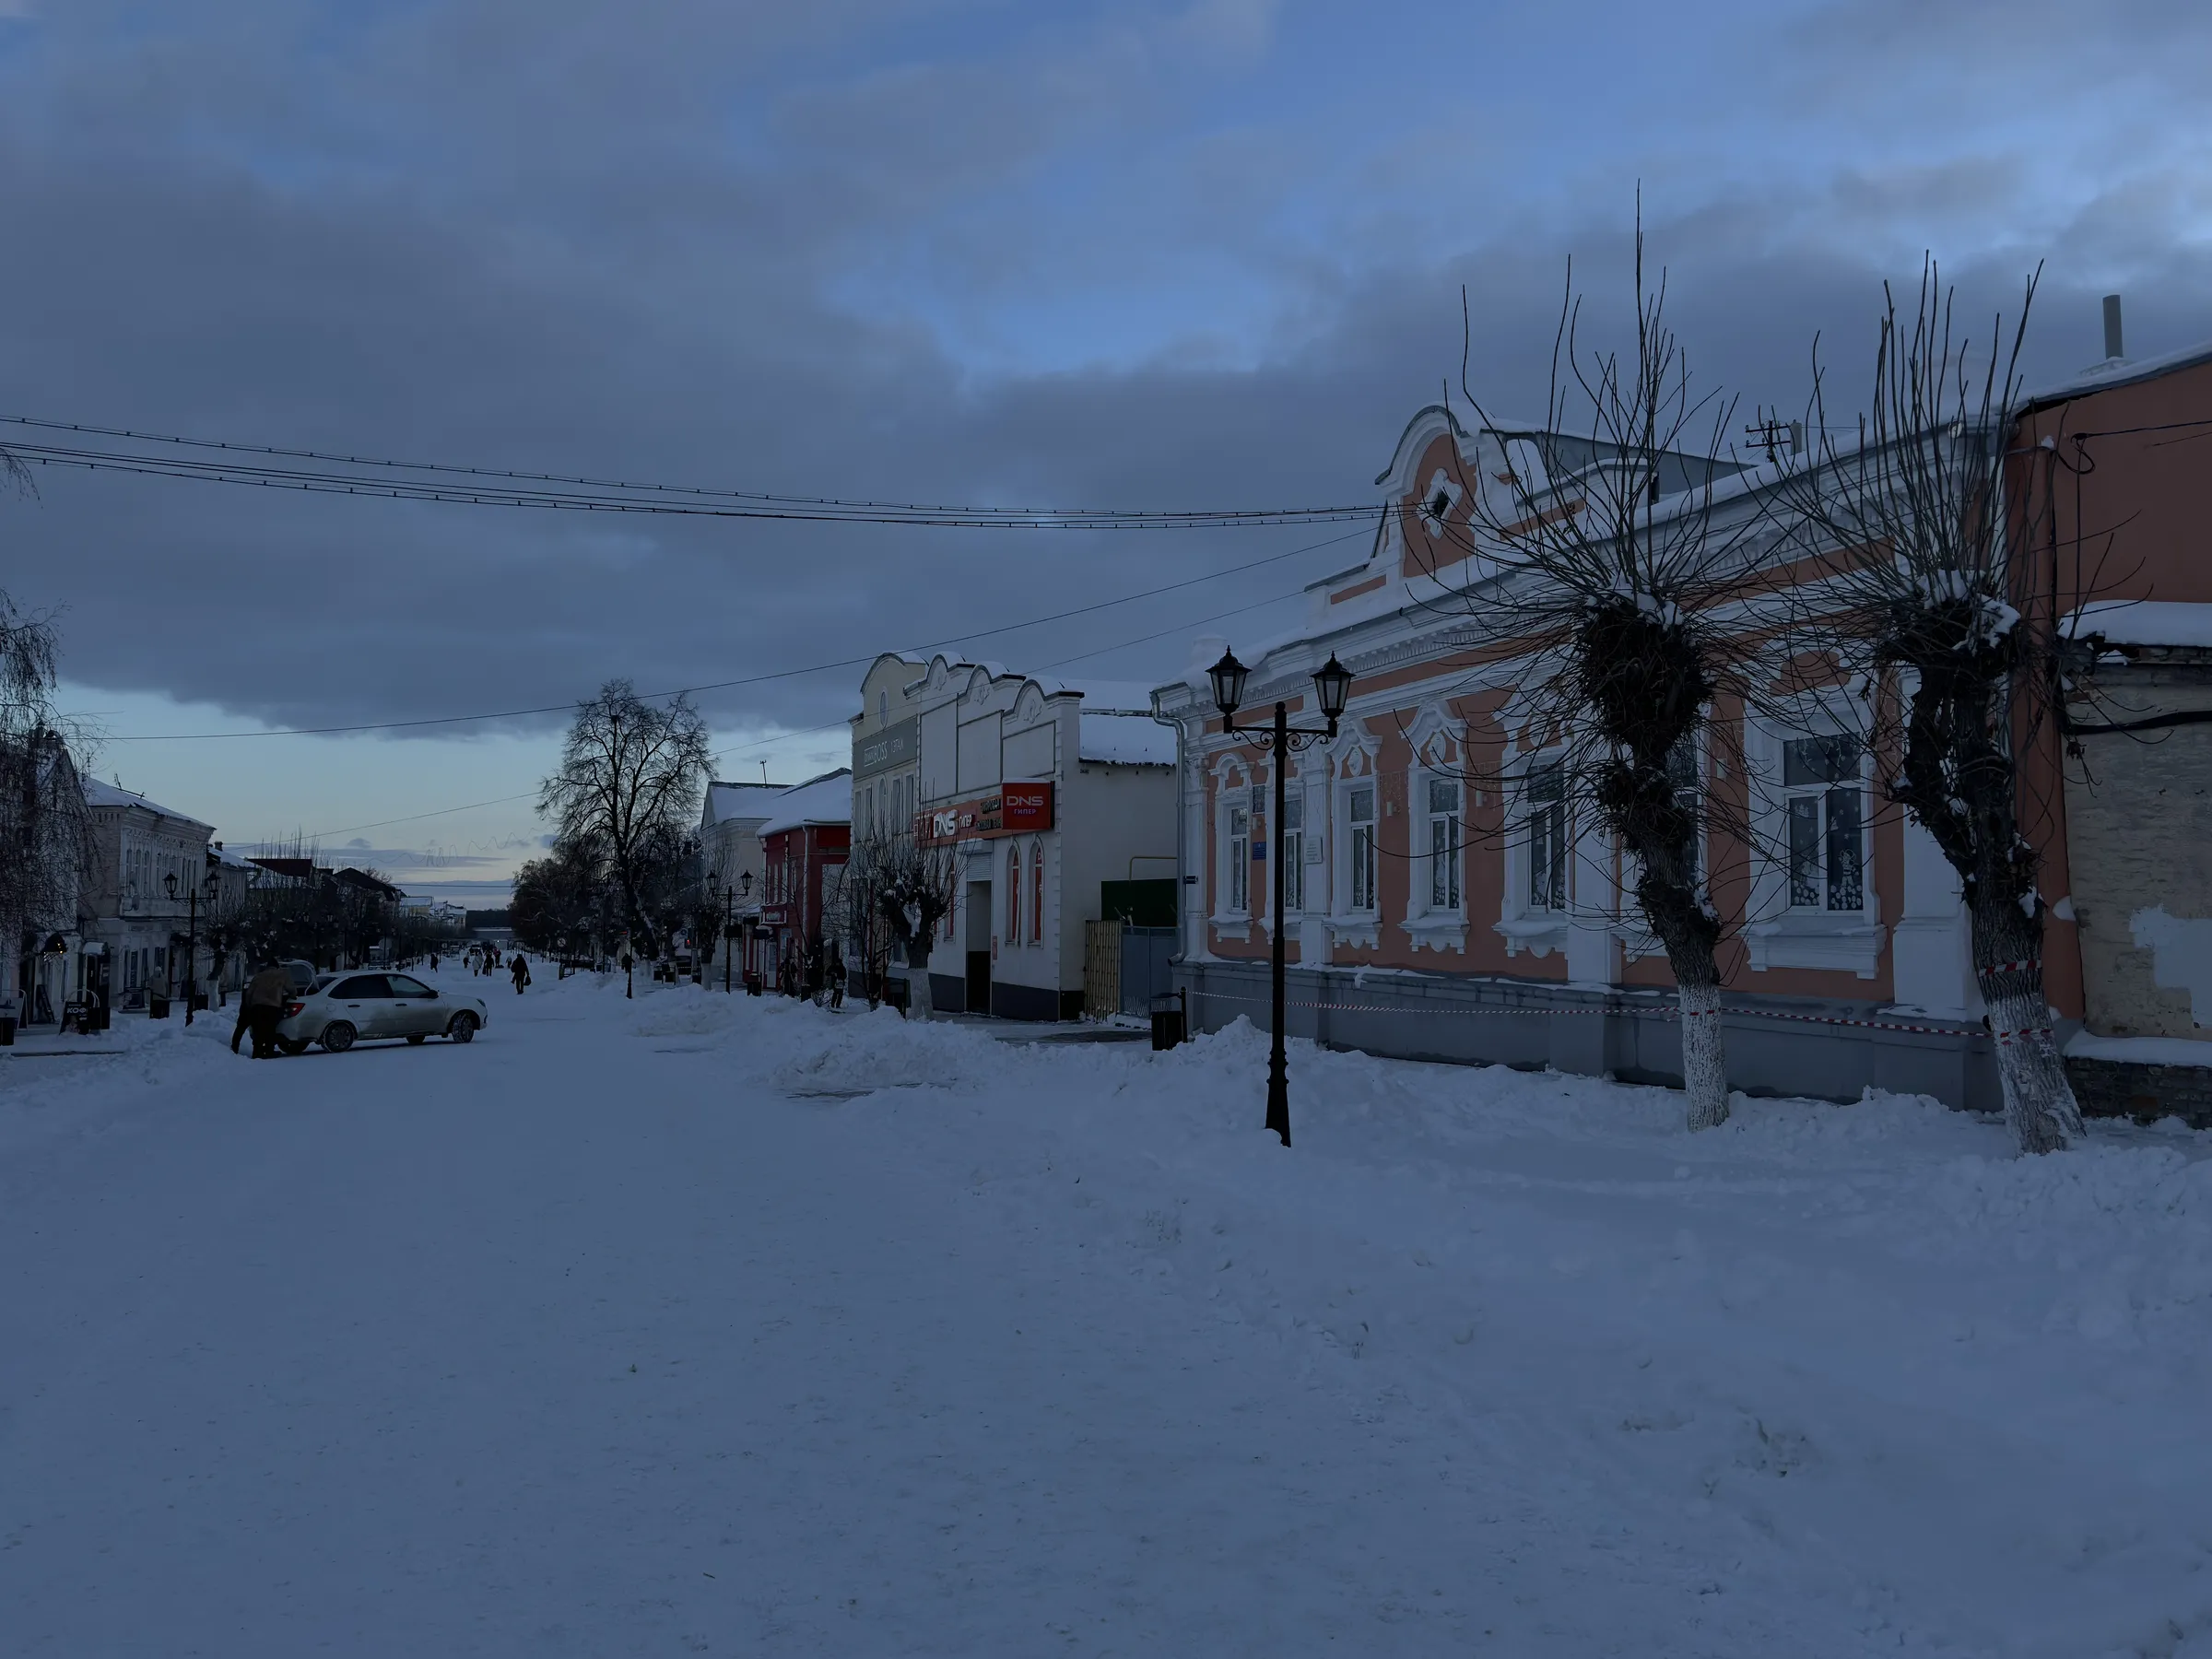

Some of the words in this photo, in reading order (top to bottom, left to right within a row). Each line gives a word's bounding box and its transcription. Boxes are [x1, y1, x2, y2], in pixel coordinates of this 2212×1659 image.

[1006, 795, 1044, 806] DNS
[933, 809, 958, 838] DNS
[959, 814, 973, 829] ГИПЕР
